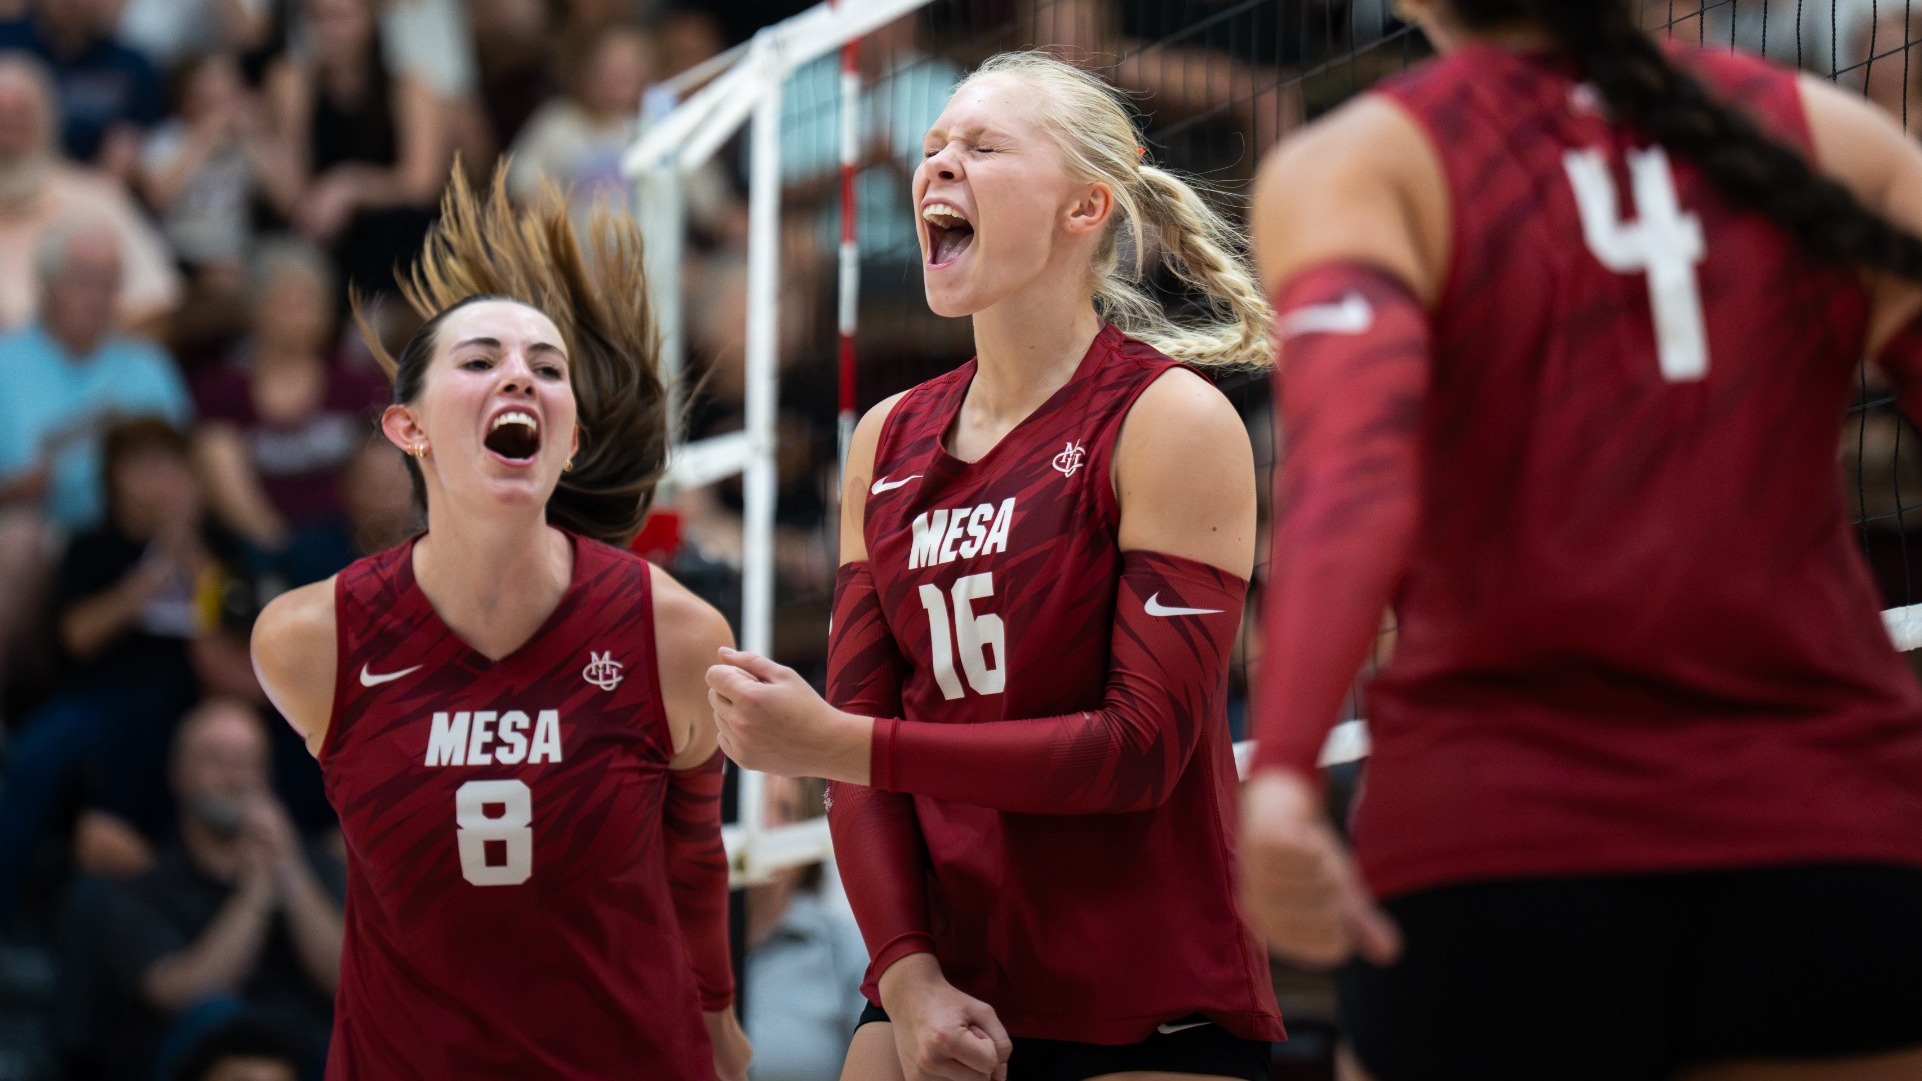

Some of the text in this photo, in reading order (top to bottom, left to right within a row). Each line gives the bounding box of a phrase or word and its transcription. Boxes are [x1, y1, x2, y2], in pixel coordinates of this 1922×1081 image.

[1562, 146, 1711, 382] 4
[908, 497, 1016, 570] MESA
[918, 572, 1006, 700] 16
[424, 709, 562, 767] MESA
[455, 779, 532, 886] 8
